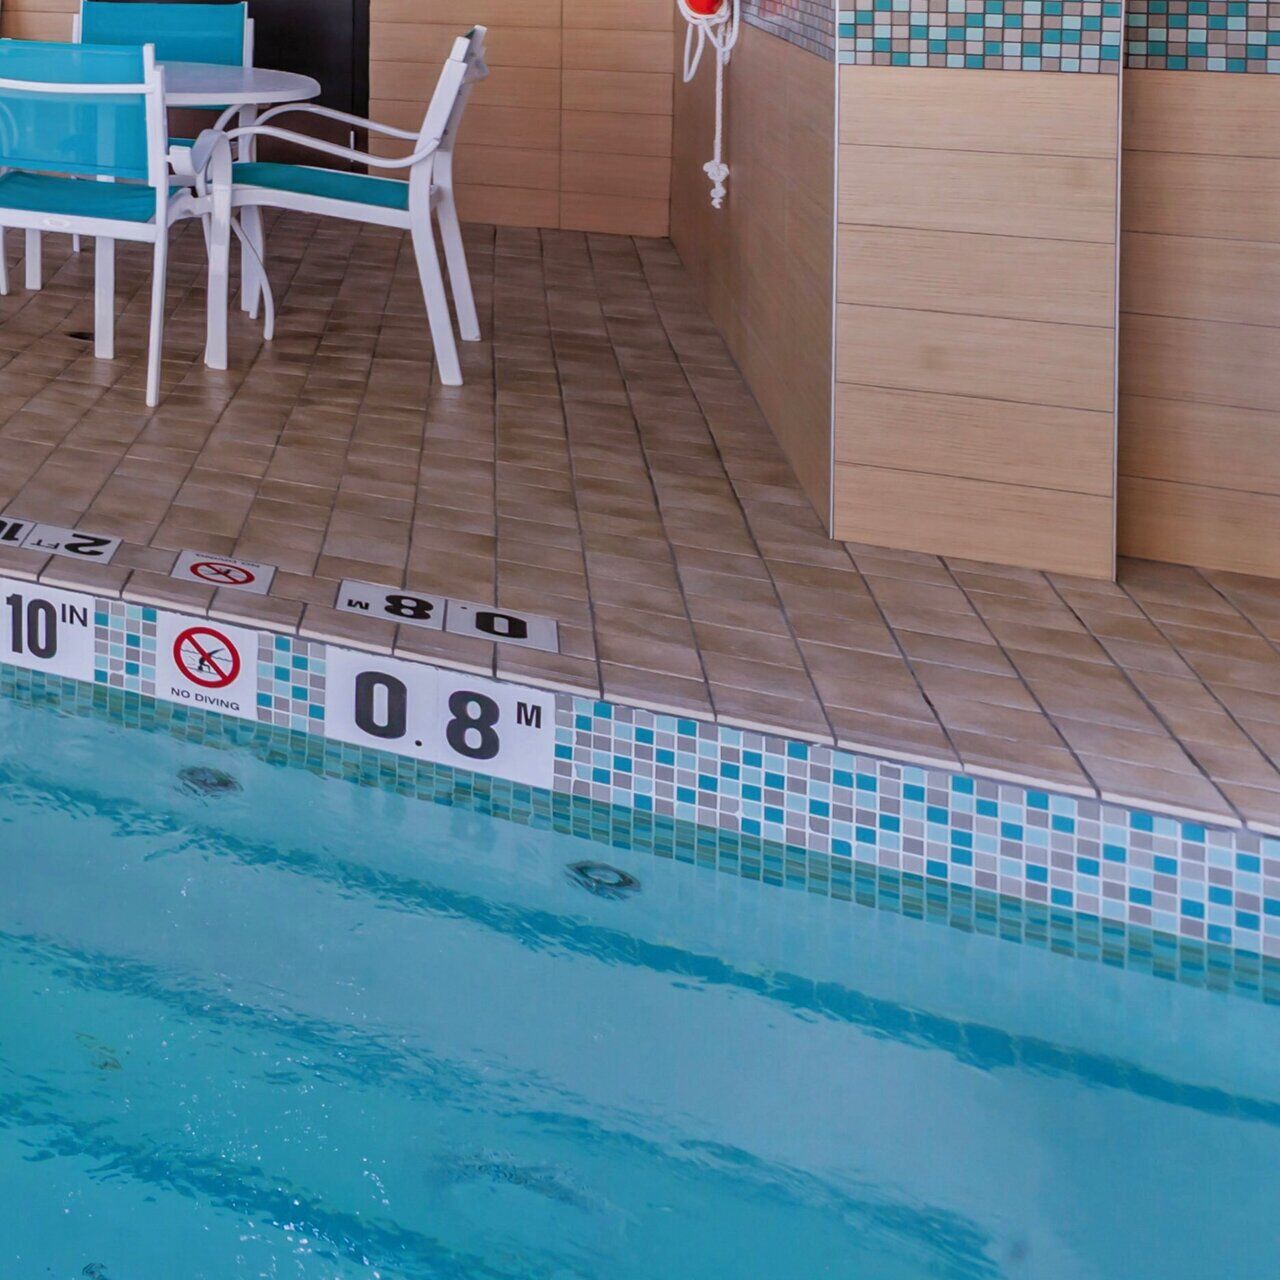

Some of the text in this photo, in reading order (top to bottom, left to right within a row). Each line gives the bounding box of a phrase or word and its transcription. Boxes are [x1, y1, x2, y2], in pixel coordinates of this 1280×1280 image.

[32, 538, 60, 549] FT
[64, 533, 111, 556] 2
[347, 598, 370, 610] M
[6, 593, 57, 659] 10
[61, 603, 88, 627] IN
[171, 687, 240, 711] NO DIVING
[516, 701, 541, 729] M
